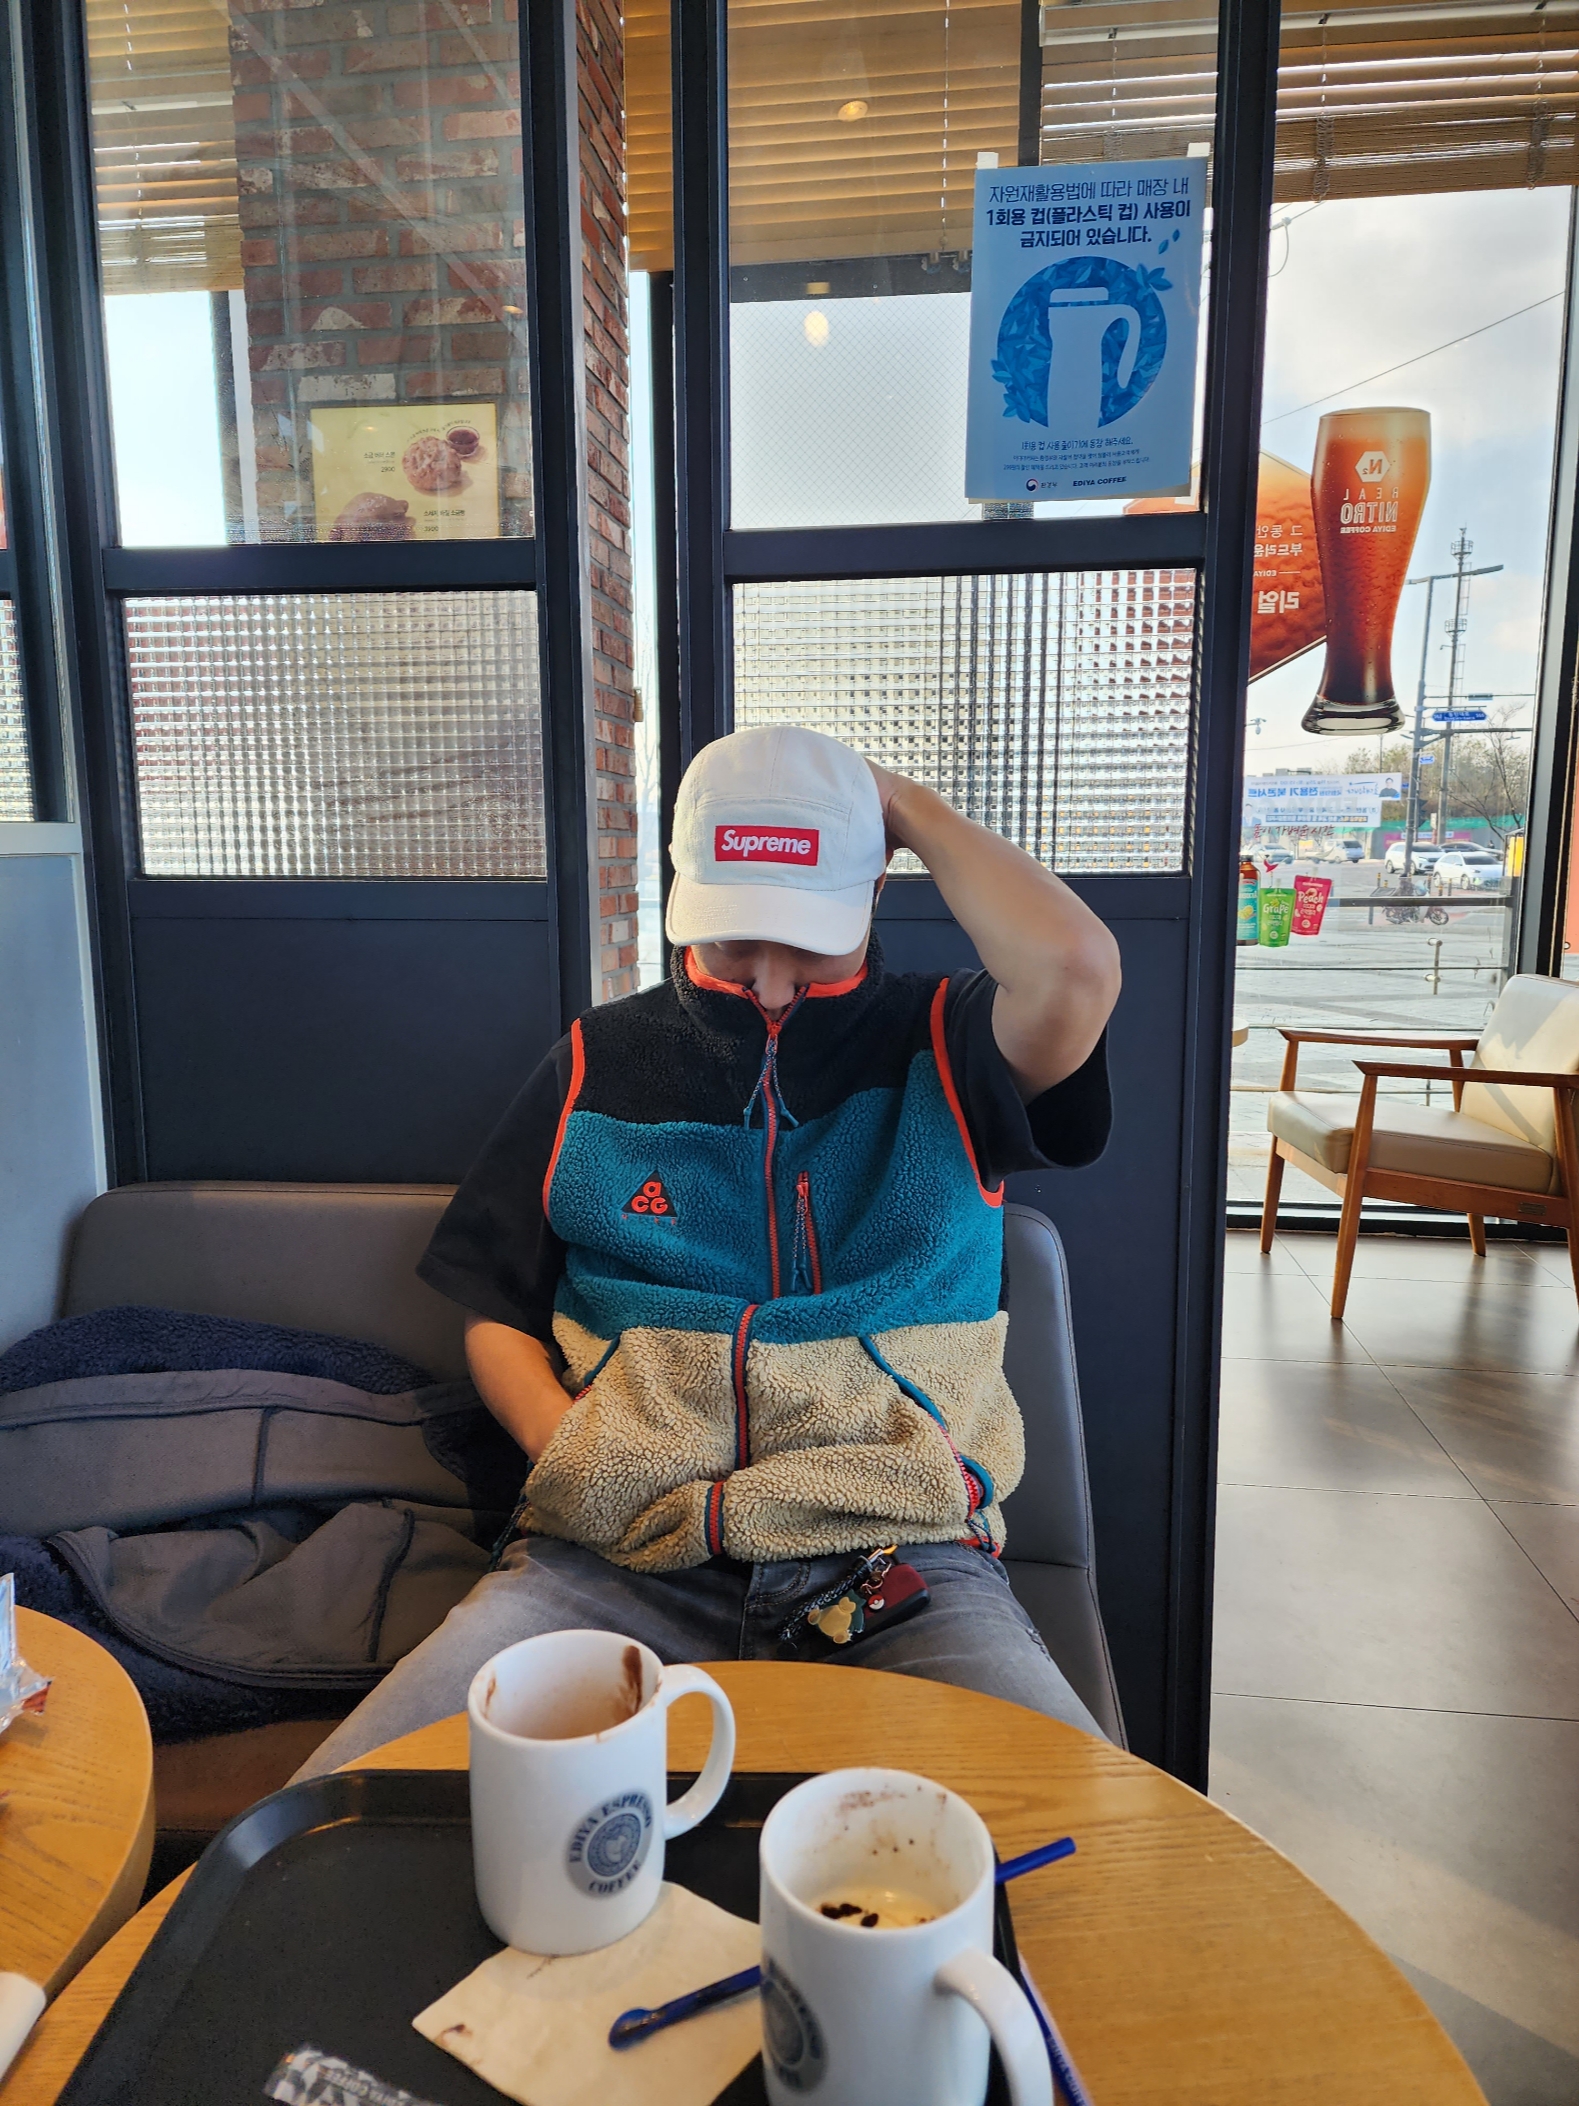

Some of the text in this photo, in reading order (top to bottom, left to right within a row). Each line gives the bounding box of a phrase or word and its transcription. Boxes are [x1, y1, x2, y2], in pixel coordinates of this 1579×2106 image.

[989, 177, 1189, 204] 자원재활용법에 따라 매장 내
[986, 200, 1190, 227] 1회용 컵(플라스틱 컵) 사용이
[1020, 226, 1153, 248] 금지되어 있습니다.
[1072, 476, 1127, 487] EDIYA COFFEE
[721, 829, 811, 857] Supreme
[1262, 902, 1290, 915] Grape
[1297, 890, 1324, 905] Peach
